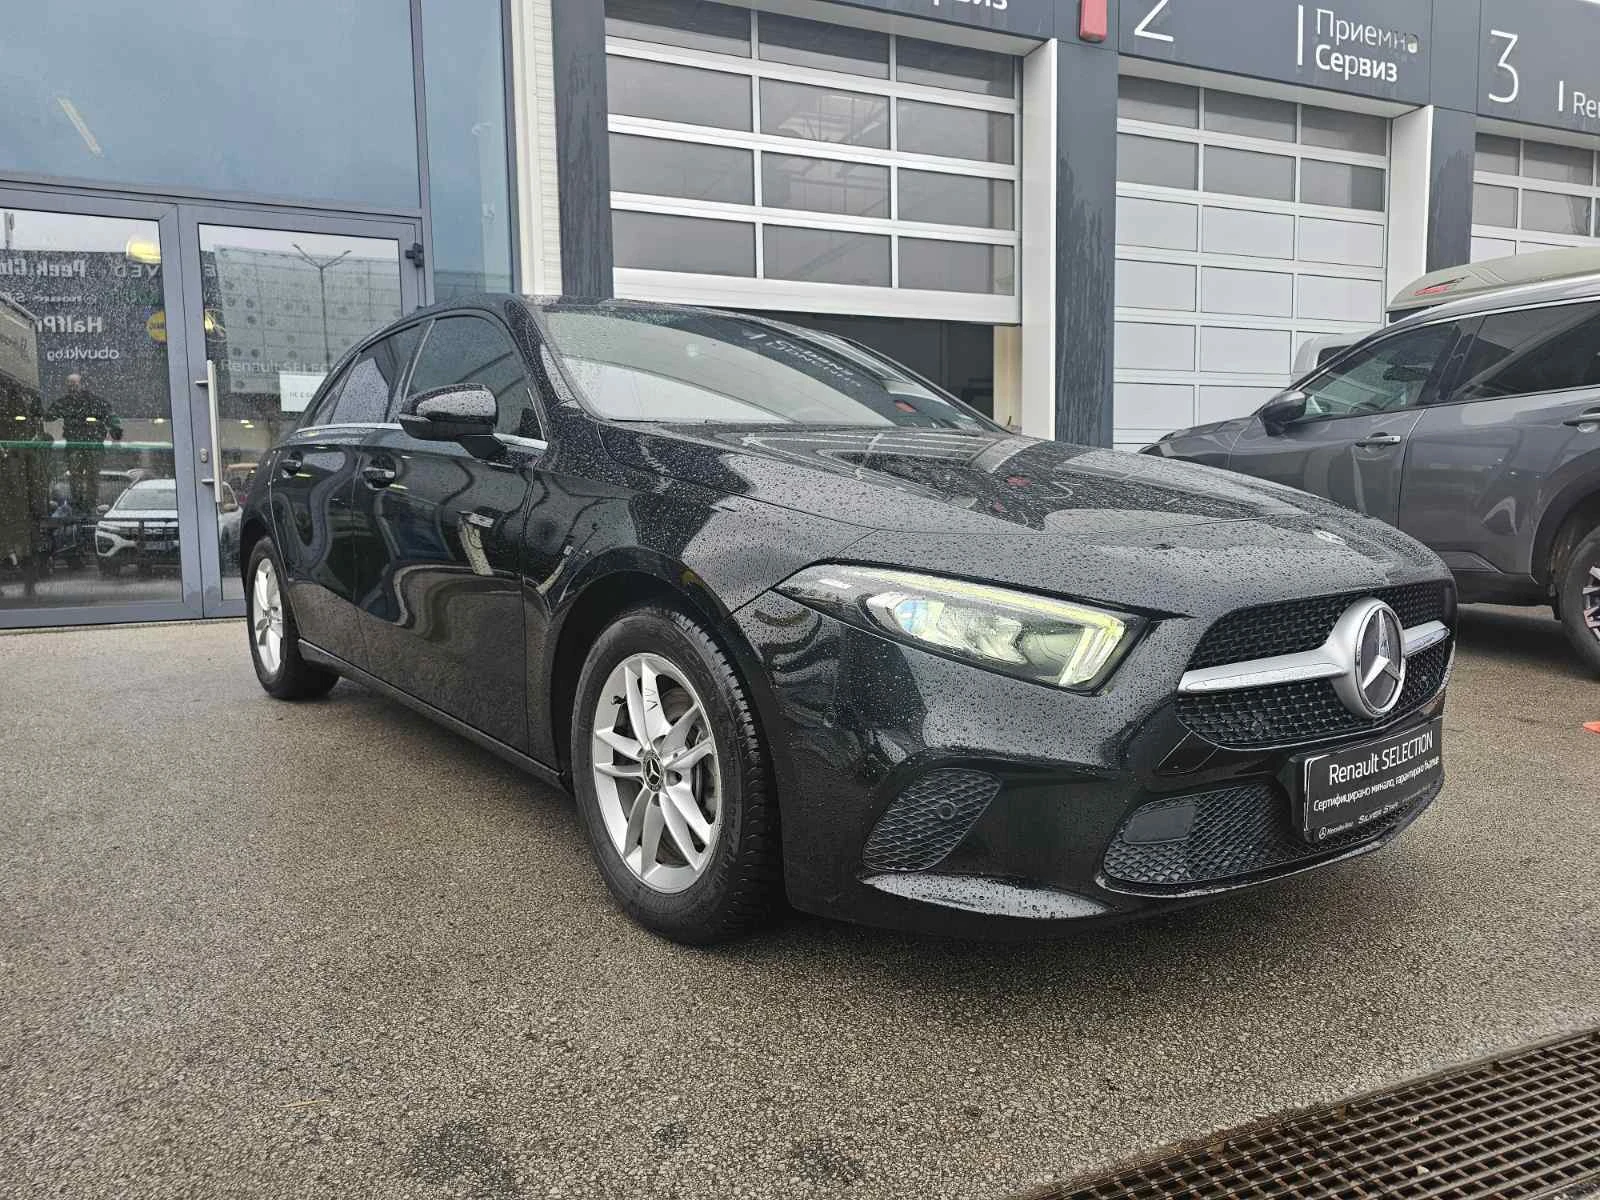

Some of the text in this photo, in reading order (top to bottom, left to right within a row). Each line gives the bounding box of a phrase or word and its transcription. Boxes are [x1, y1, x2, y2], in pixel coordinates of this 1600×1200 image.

[1315, 43, 1398, 83] Сервиз
[1488, 29, 1519, 104] 3
[221, 359, 279, 373] Renault
[1329, 730, 1433, 786] Renault SELECTION
